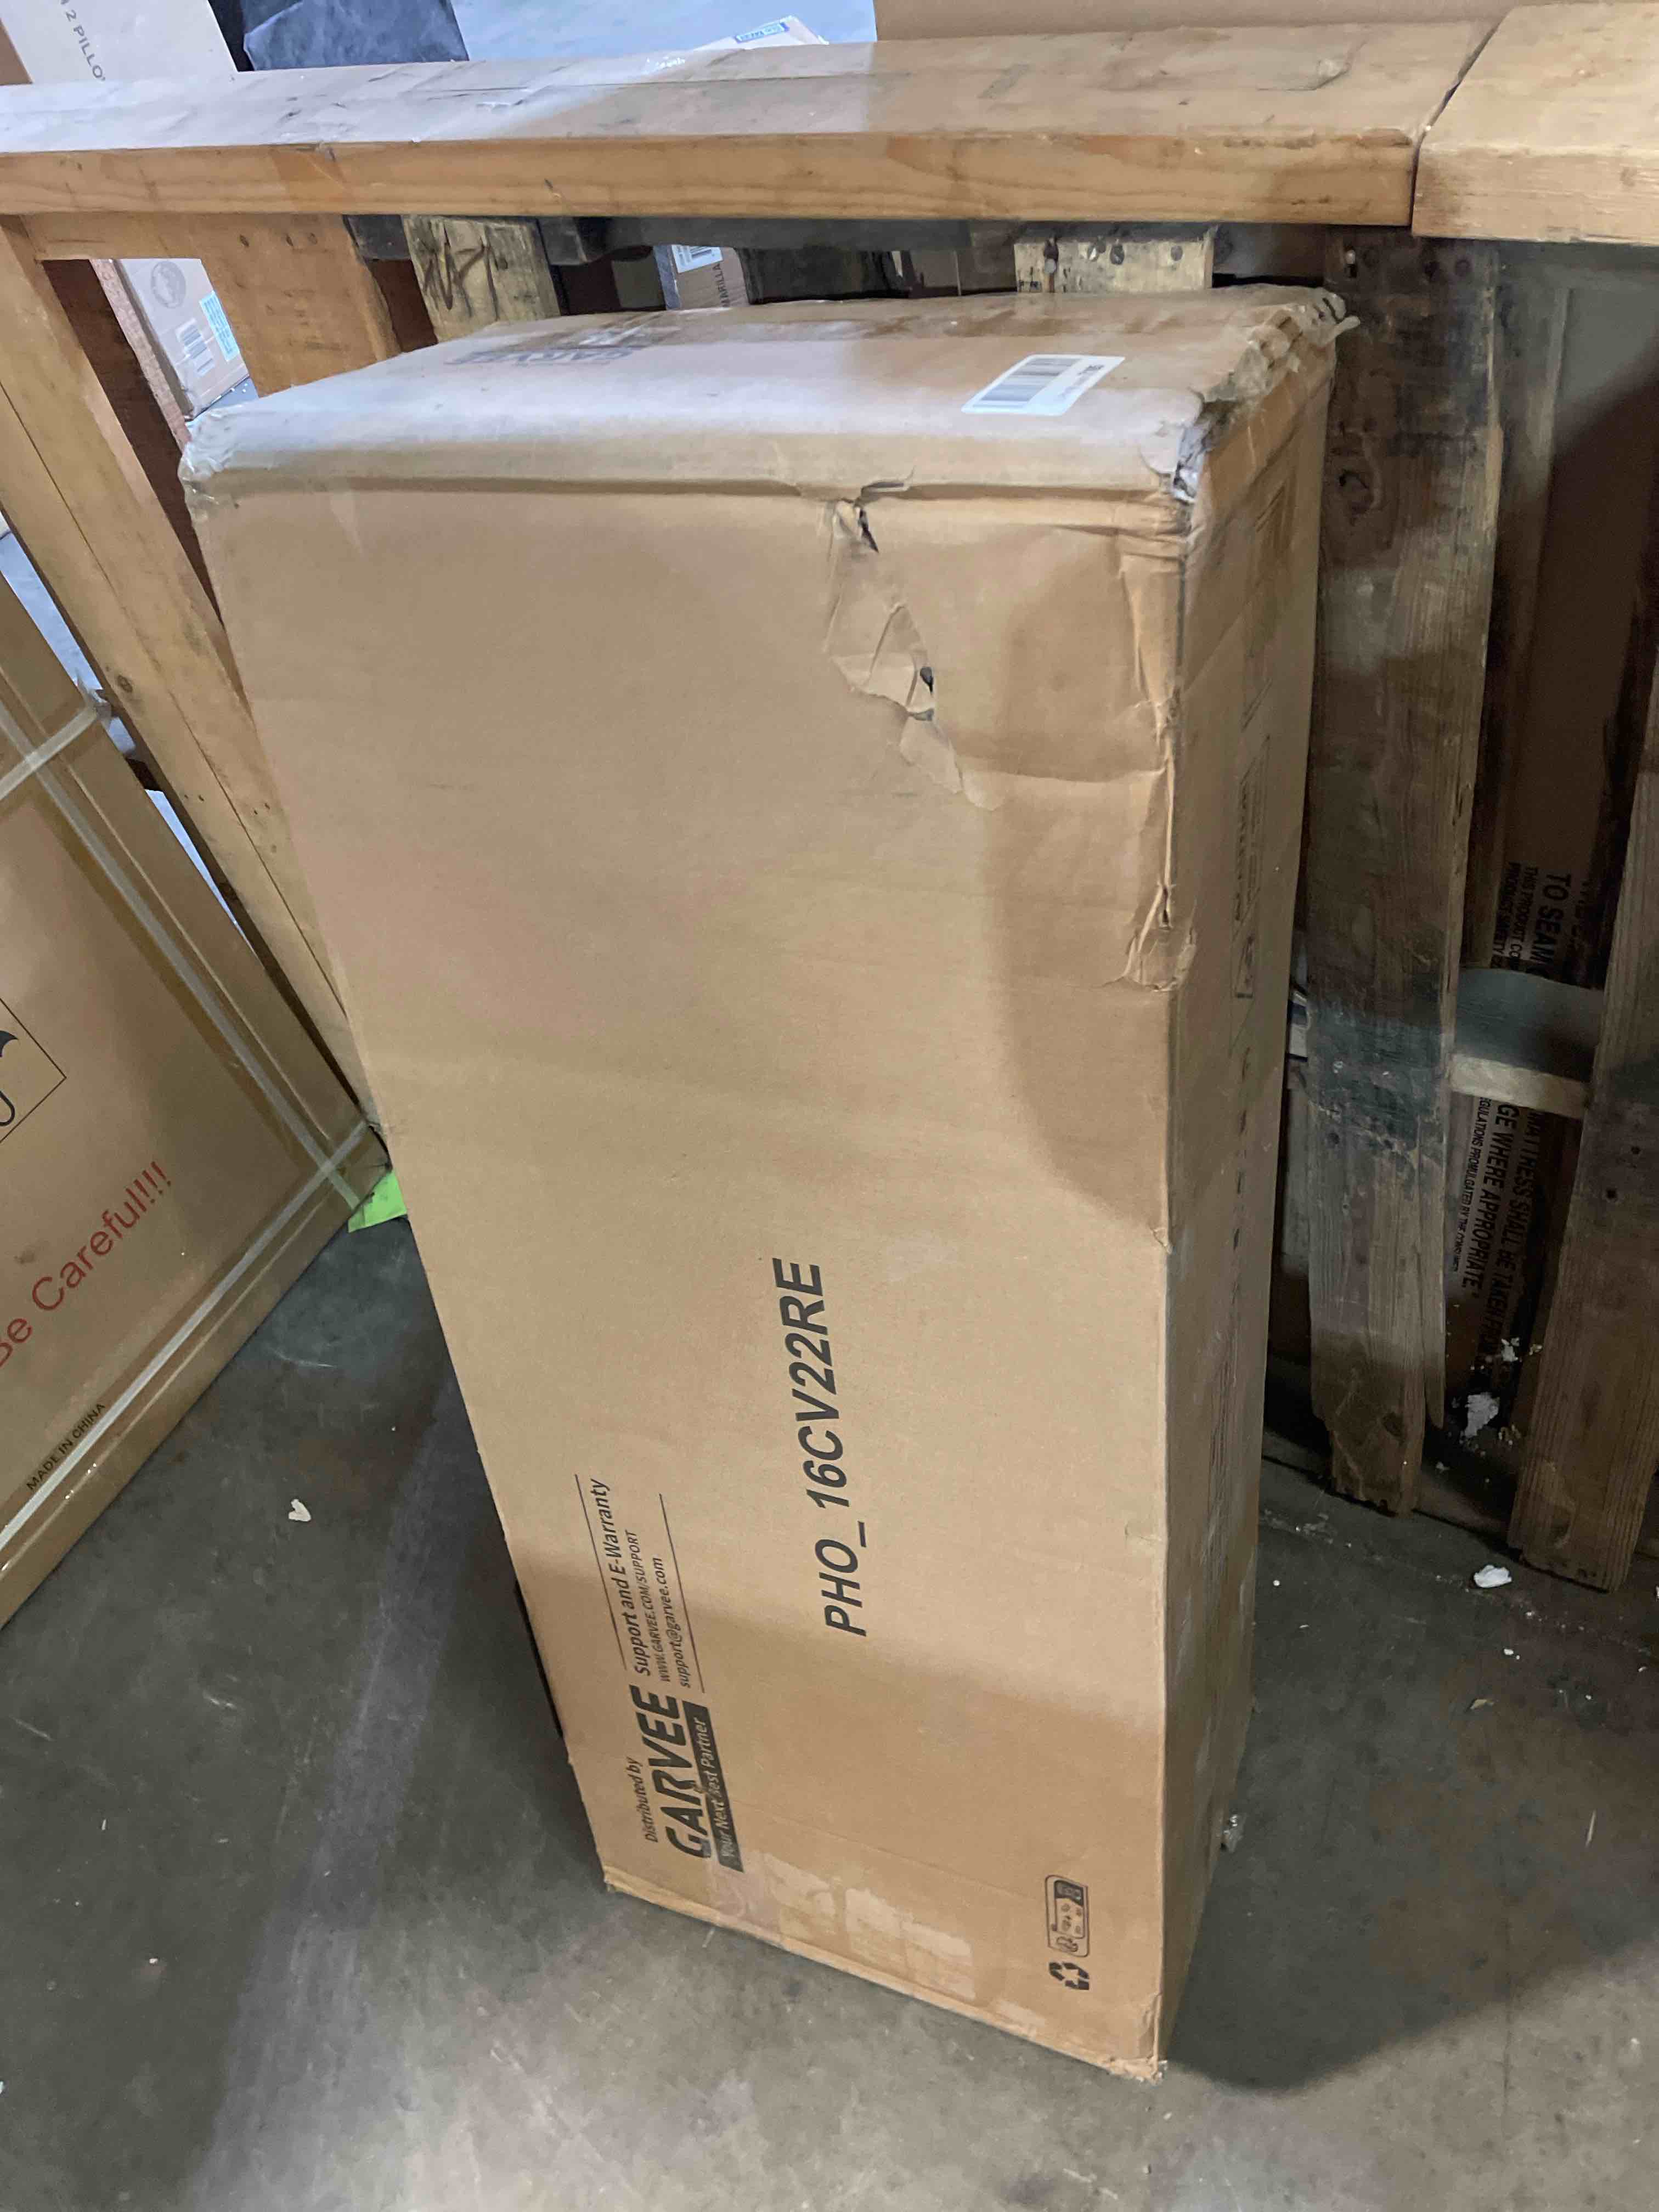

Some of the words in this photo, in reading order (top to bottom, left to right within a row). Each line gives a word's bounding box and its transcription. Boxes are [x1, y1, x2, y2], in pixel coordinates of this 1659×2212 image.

[65, 9, 77, 22] 2
[74, 25, 105, 81] PILLO
[1543, 874, 1571, 901] TO
[1496, 1104, 1520, 1130] GE
[1483, 1133, 1514, 1188] WHERE
[32, 1161, 172, 1311] Careful!!!
[26, 1457, 59, 1490] MADE
[58, 1439, 72, 1454] IN
[72, 1403, 105, 1438] CHINA
[591, 1479, 625, 1576] E-Warranty
[611, 1577, 634, 1610] and
[625, 1530, 670, 1682] WWW.GARVEE.COM/SUPPORT
[653, 1558, 690, 1688] support@garvee.com
[622, 1611, 651, 1677] Support
[626, 1757, 643, 1773] by
[629, 1684, 712, 1858] GARVEE
[693, 1717, 715, 1769] Partner
[628, 1774, 658, 1843] Distributed
[712, 1798, 729, 1829] Next
[719, 1829, 735, 1858] Your
